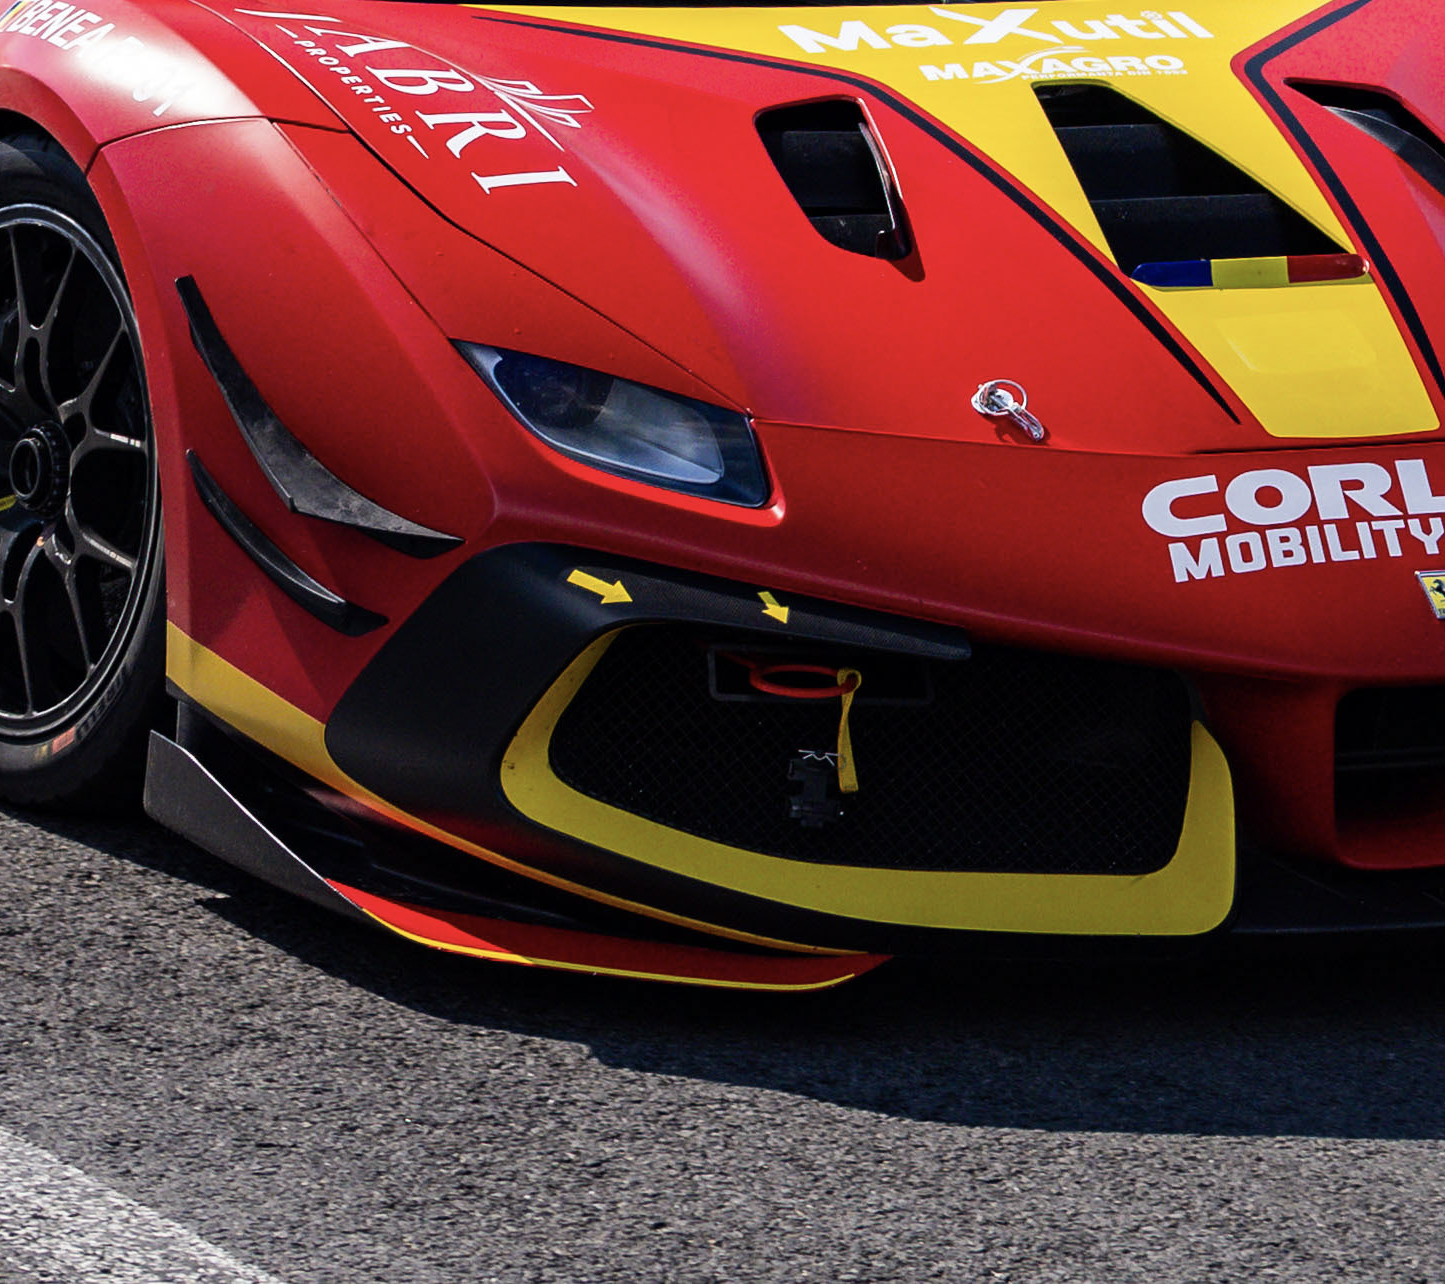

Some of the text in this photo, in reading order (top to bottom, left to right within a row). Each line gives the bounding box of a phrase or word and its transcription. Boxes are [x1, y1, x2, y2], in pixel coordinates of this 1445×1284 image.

[235, 4, 579, 198] JABRI
[289, 34, 415, 137] PROPERTIES
[918, 53, 1185, 83] MAXAGRO
